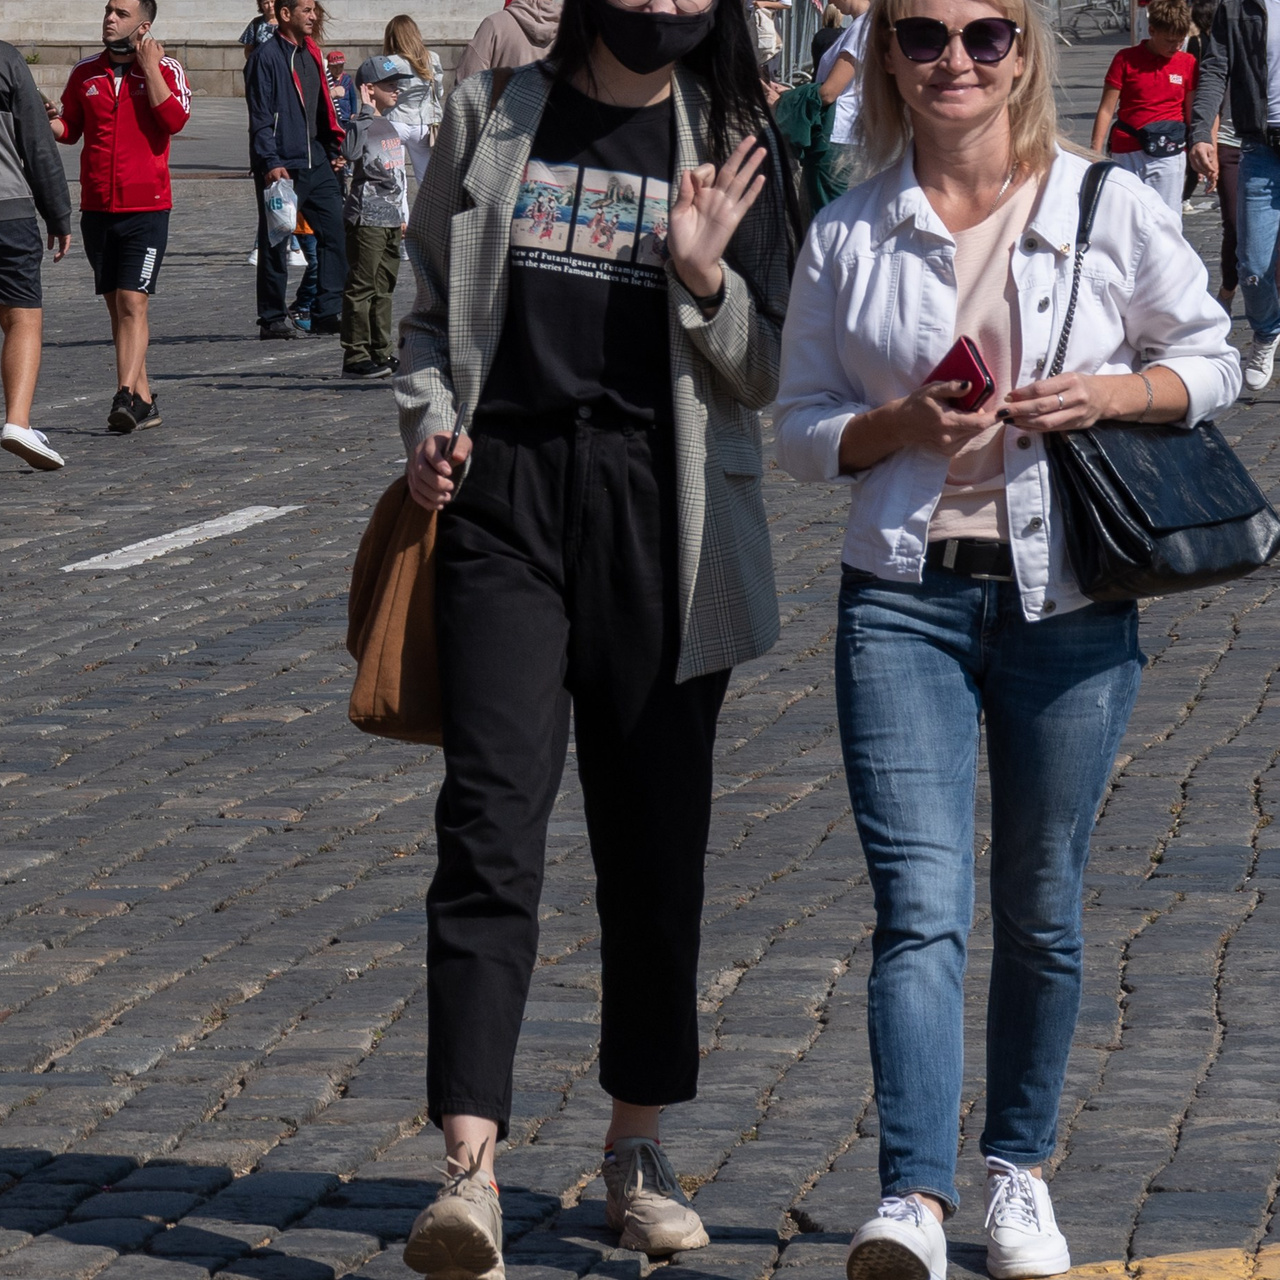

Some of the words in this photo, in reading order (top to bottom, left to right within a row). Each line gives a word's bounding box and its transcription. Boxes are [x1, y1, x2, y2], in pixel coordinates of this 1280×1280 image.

[528, 251, 540, 259] of
[541, 251, 597, 269] Futamigaura
[525, 260, 539, 268] the
[539, 262, 562, 271] series
[563, 265, 594, 277] Famous
[595, 270, 619, 282] Places
[621, 275, 630, 283] in
